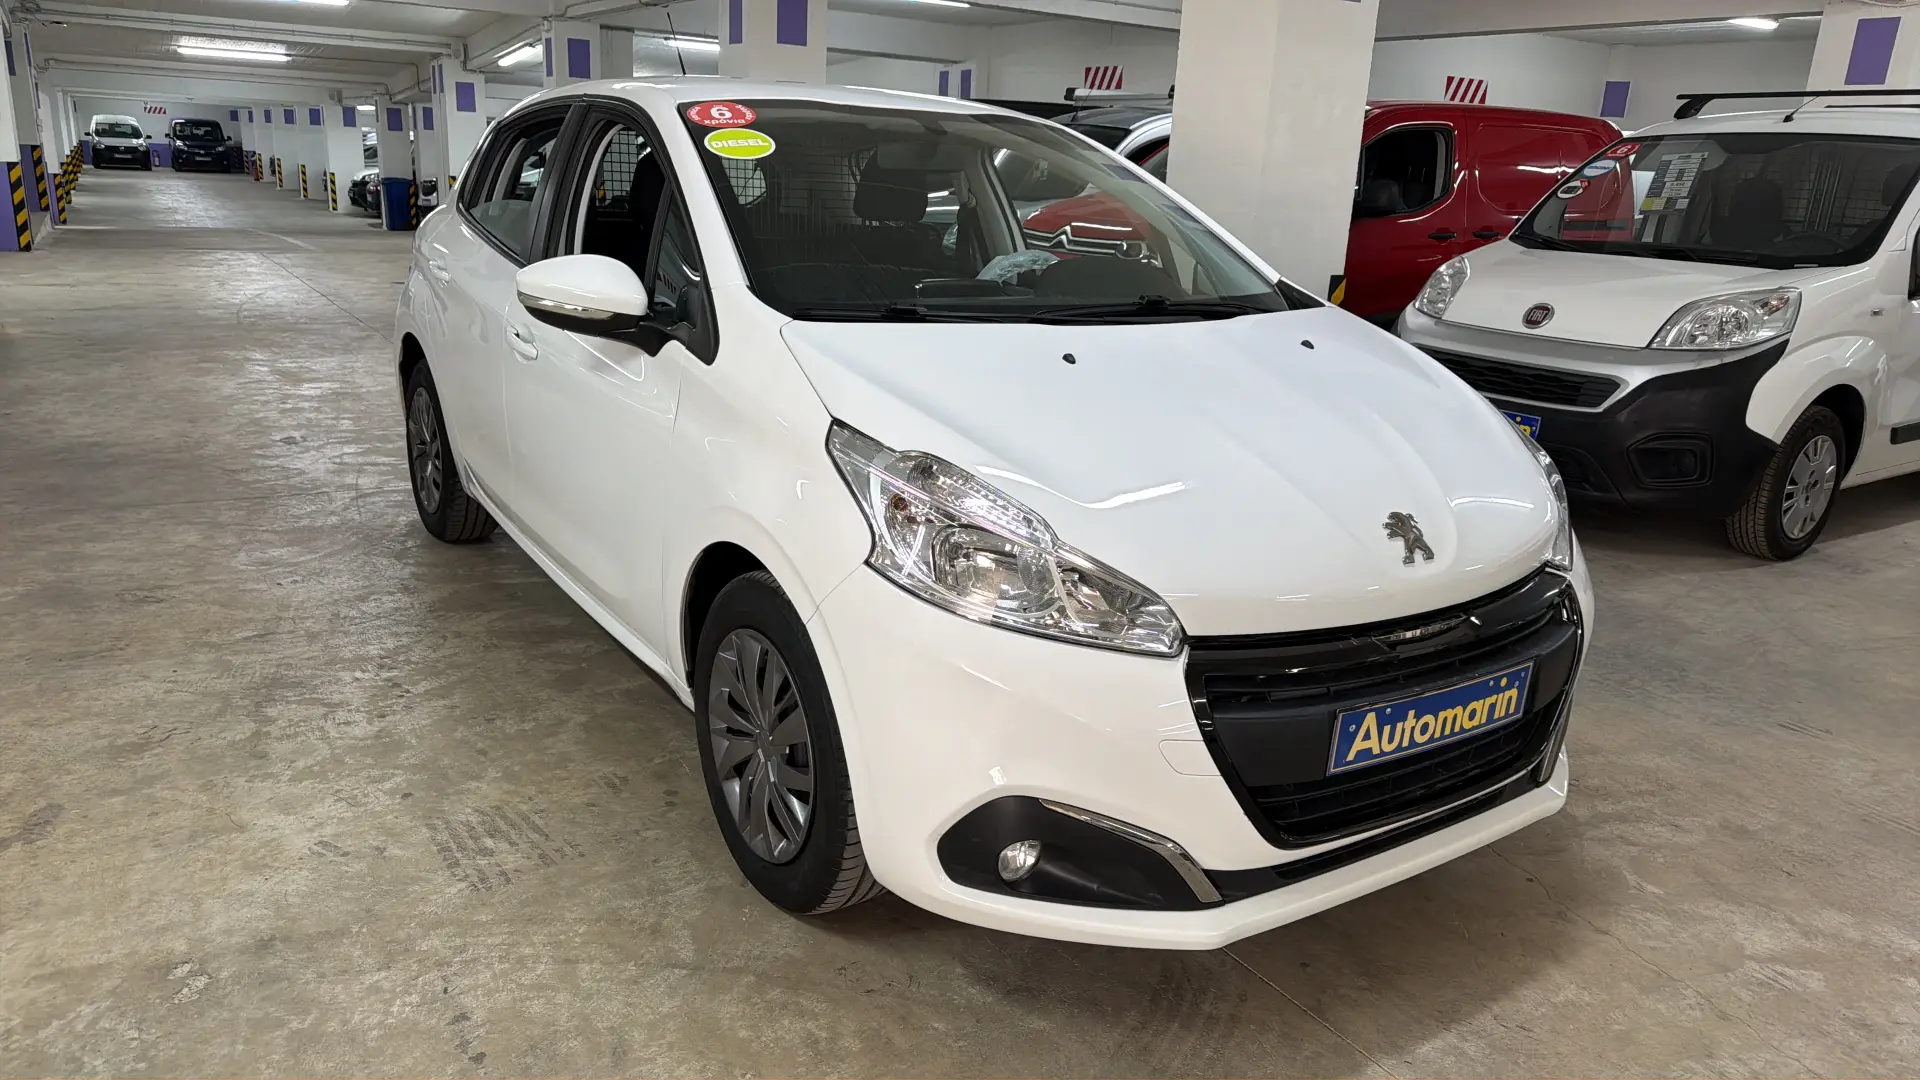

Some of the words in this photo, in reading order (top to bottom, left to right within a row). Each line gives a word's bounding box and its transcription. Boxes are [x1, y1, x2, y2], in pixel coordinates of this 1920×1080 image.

[710, 106, 732, 119] 6
[711, 138, 769, 148] DIESEL
[1528, 308, 1548, 322] FIAT
[1345, 677, 1519, 762] Automarin
